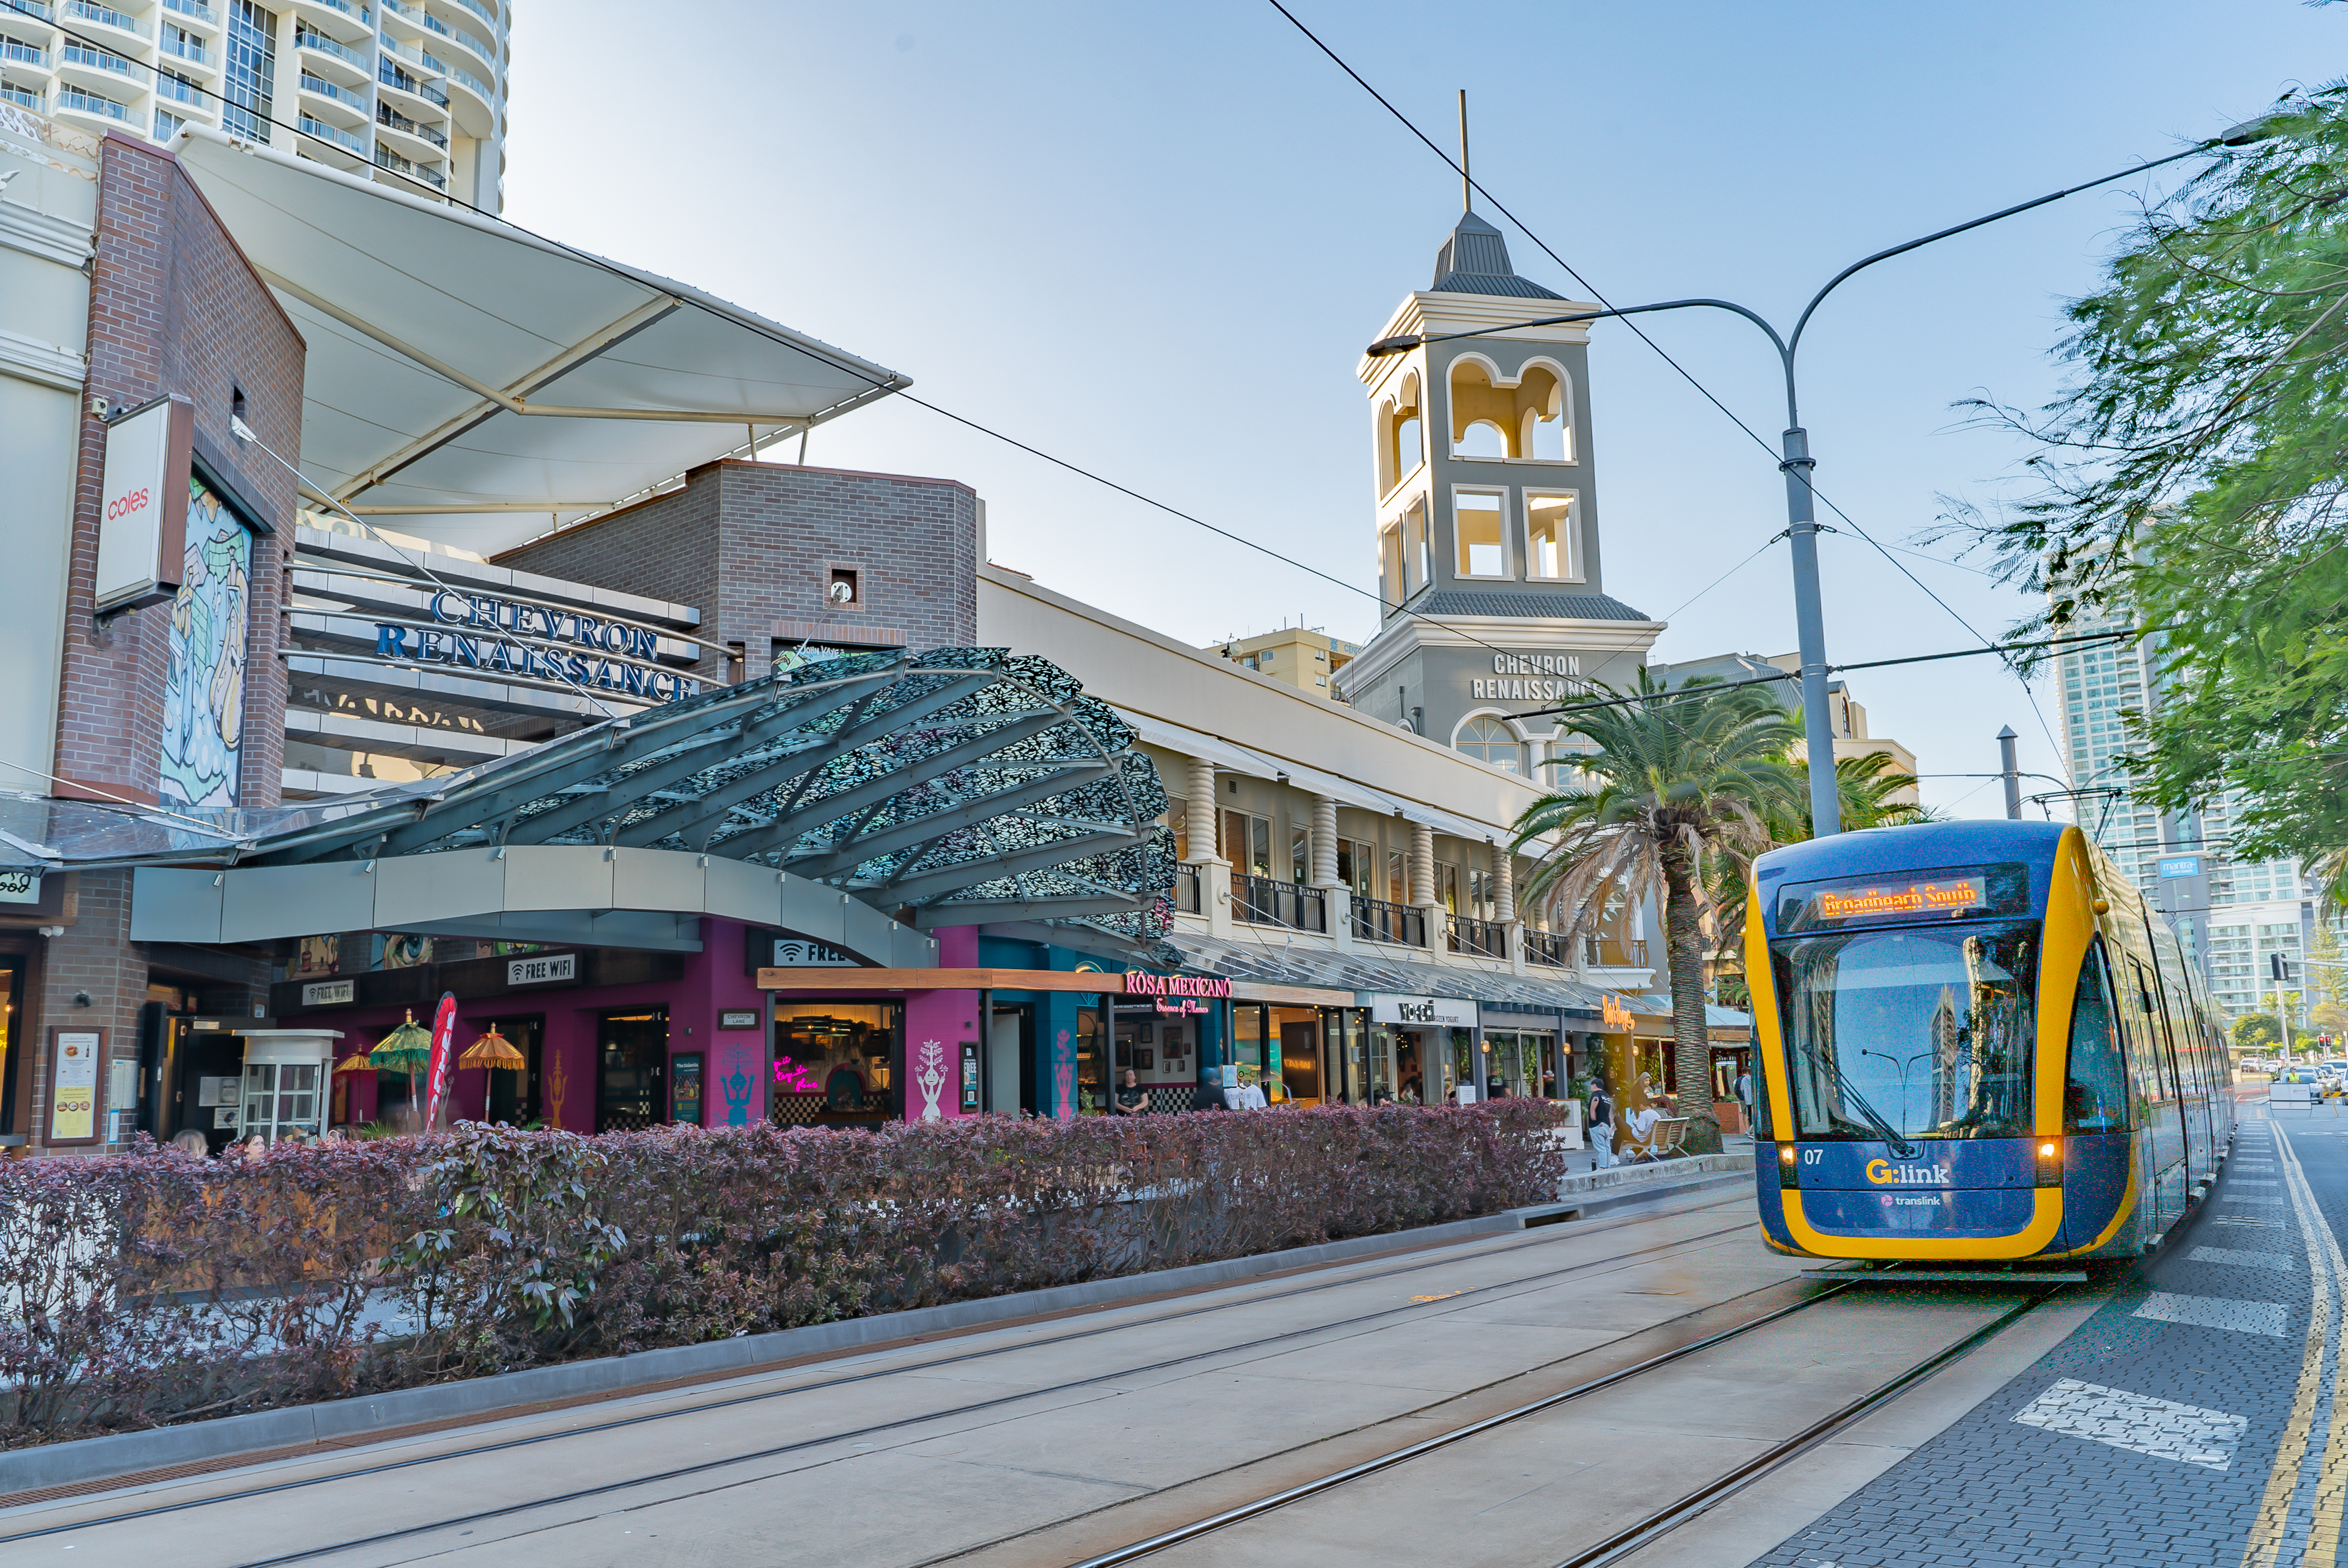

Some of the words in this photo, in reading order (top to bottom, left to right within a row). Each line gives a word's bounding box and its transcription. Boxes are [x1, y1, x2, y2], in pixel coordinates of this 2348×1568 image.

[108, 488, 148, 521] coles
[430, 590, 660, 661] CHEVRON
[800, 646, 820, 655] JOHN
[821, 645, 840, 657] KAYE
[373, 623, 692, 702] RENAISSANCE
[1494, 654, 1580, 676] CHEVRON
[526, 962, 546, 979] FREE
[549, 960, 571, 977] WIFI
[1180, 1000, 1186, 1018] of
[964, 1062, 977, 1073] FREE
[1804, 1149, 1823, 1165] 07
[1866, 1159, 1950, 1184] G:link
[1895, 1196, 1941, 1205] translink
